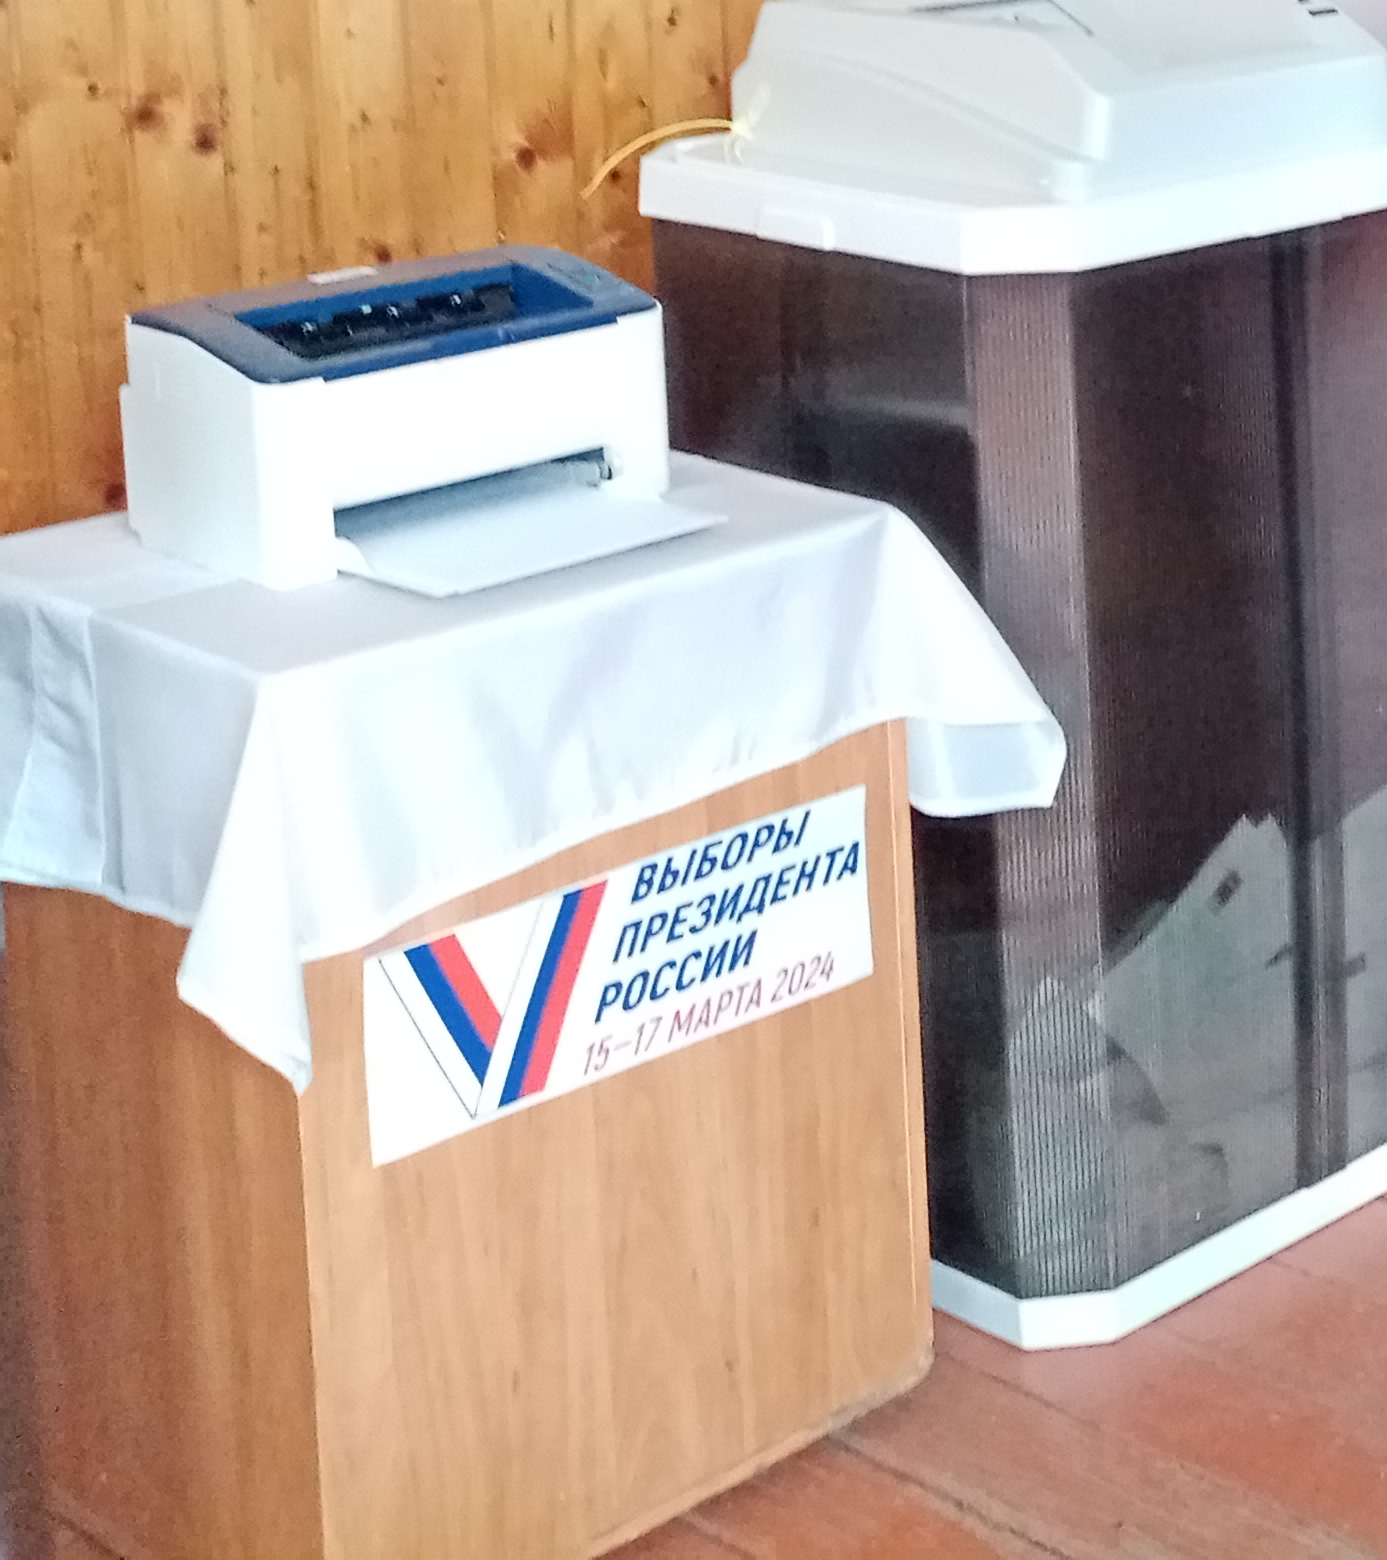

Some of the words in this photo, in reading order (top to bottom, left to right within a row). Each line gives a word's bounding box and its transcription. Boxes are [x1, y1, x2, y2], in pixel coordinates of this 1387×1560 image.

[612, 840, 861, 964] ПРЕЗИДЕНТА
[631, 810, 812, 905] ВЫБОРЫ
[595, 930, 758, 1025] РОССИИ
[668, 978, 764, 1045] МАРТА
[771, 950, 836, 1004] 2024
